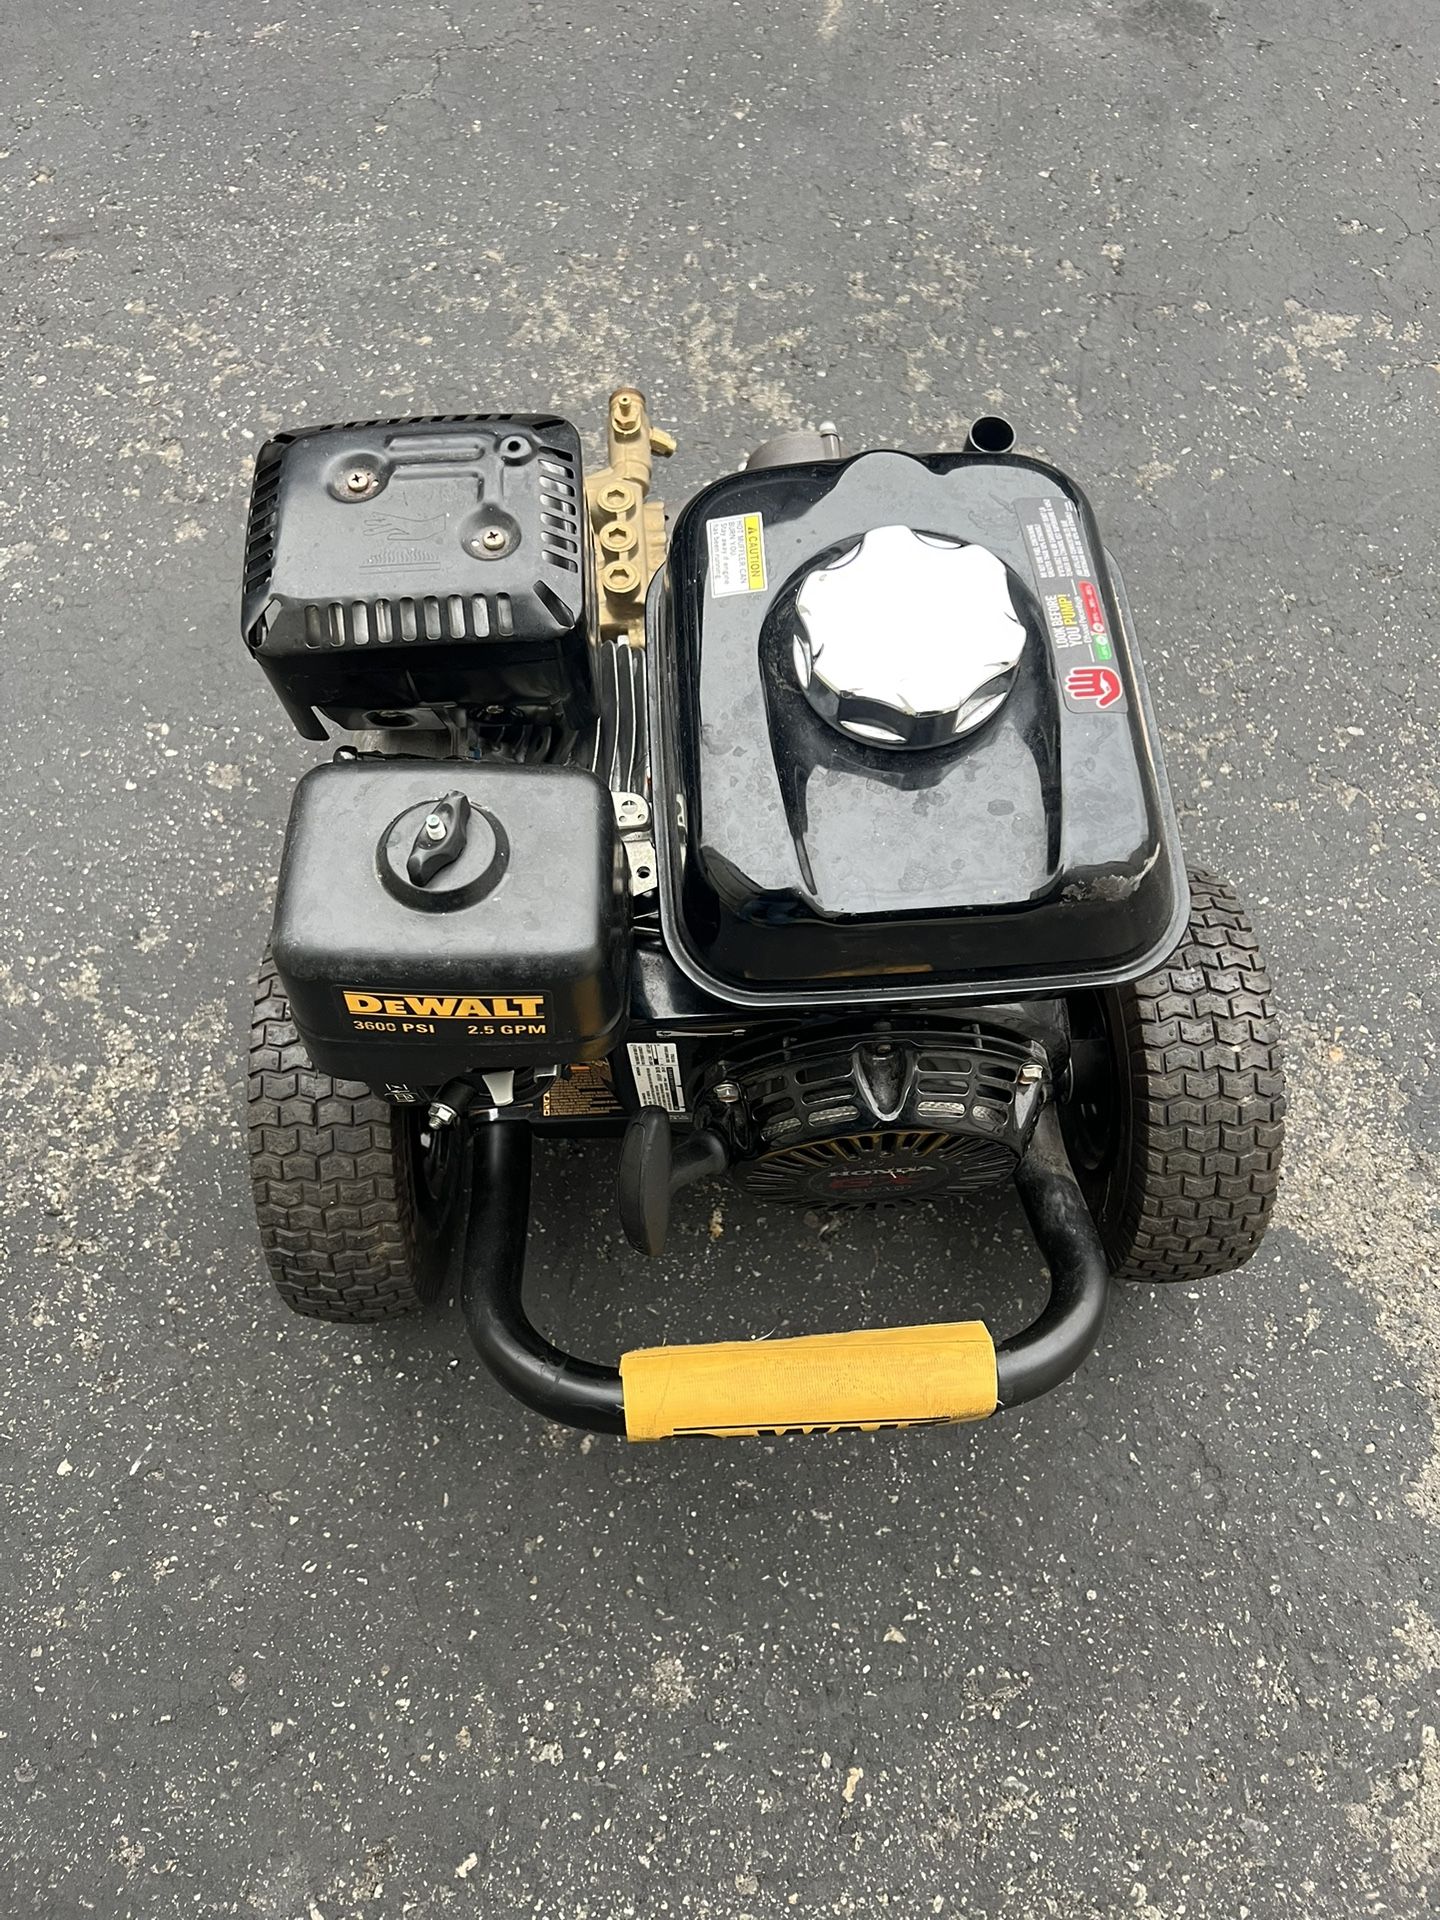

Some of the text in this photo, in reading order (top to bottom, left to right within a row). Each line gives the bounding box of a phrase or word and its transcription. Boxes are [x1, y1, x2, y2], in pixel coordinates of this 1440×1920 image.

[728, 521, 736, 540] BURN
[737, 535, 746, 567] MUFFLER
[748, 536, 761, 578] CAUTION
[739, 568, 747, 584] CAN
[1045, 594, 1064, 627] BEFORE
[1057, 593, 1077, 625] PUMP!
[1053, 626, 1069, 648] LOOK
[1065, 626, 1083, 647] YOU
[353, 1020, 546, 1035] 3600 PSI 2.5 GPM
[829, 1166, 937, 1178] HONDA
